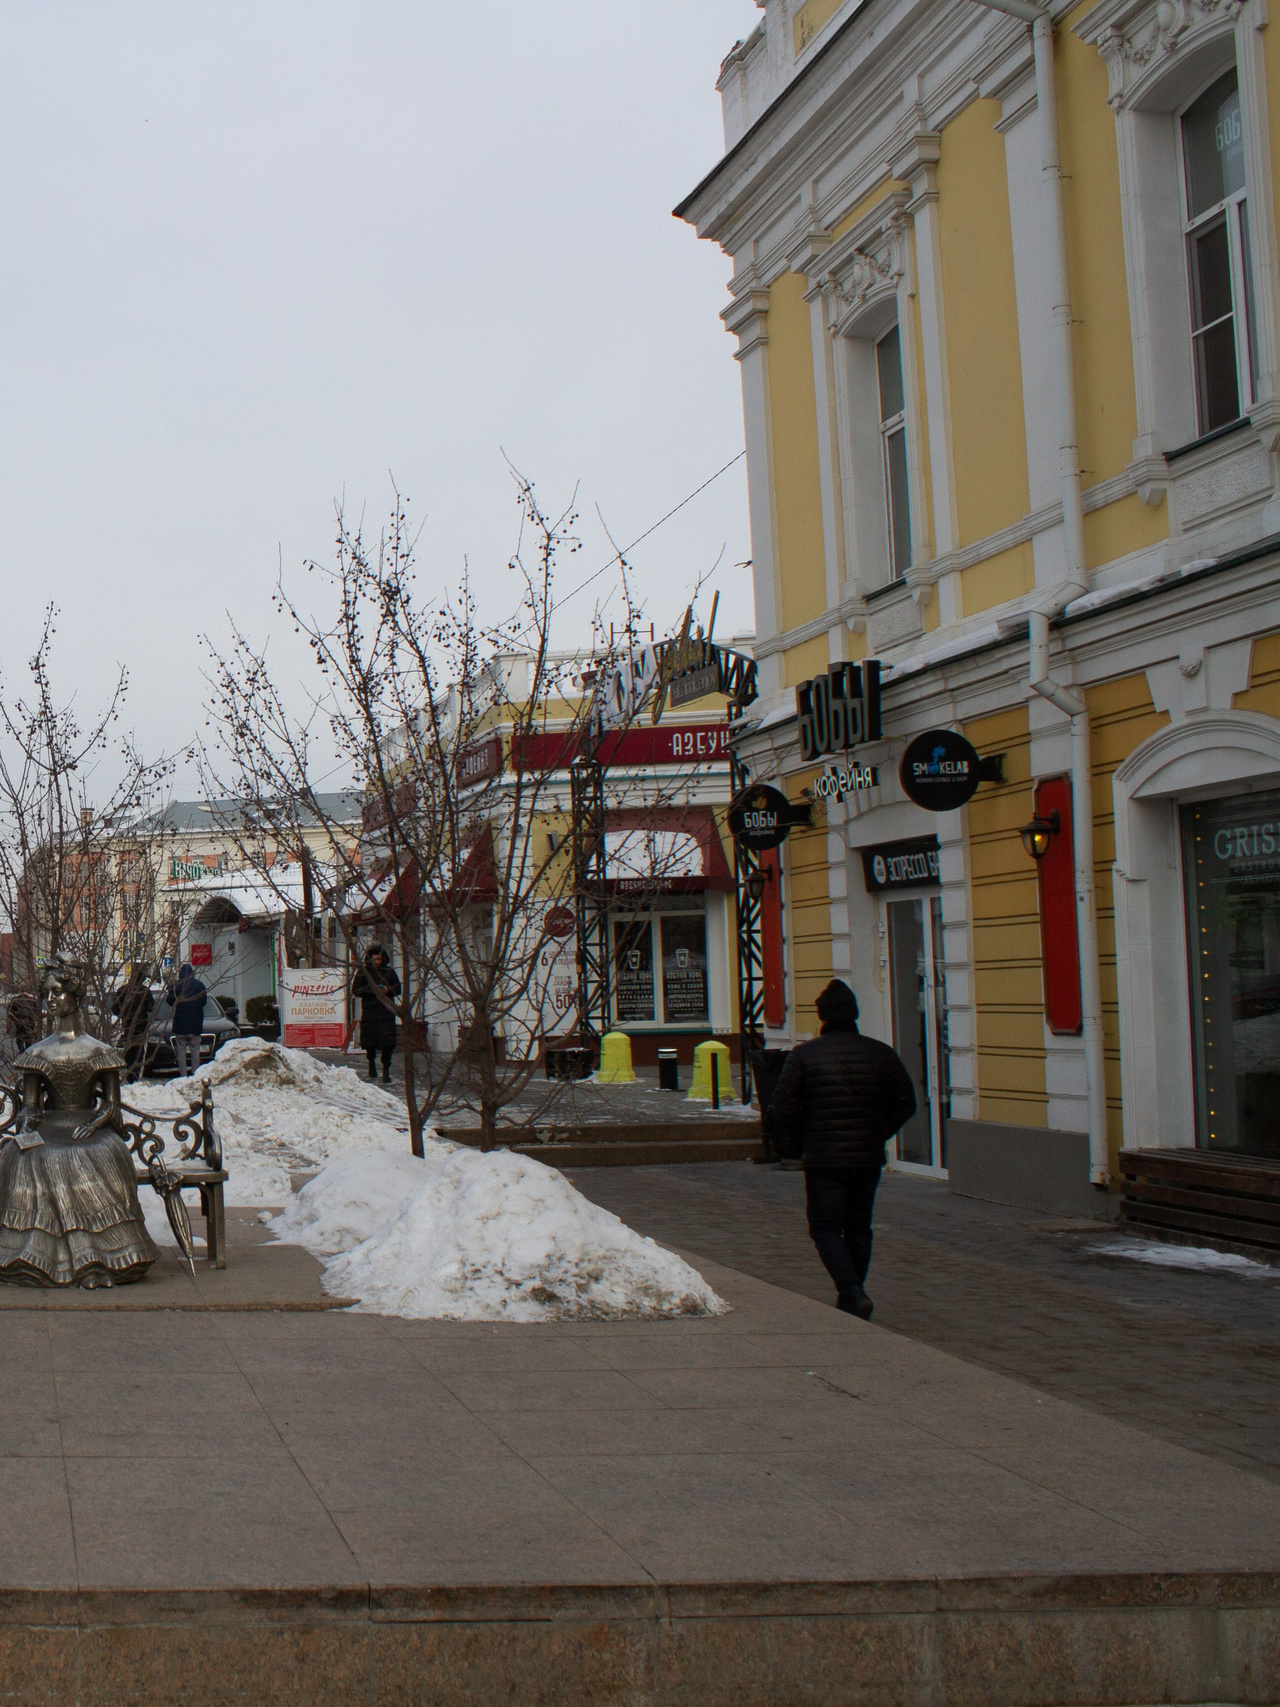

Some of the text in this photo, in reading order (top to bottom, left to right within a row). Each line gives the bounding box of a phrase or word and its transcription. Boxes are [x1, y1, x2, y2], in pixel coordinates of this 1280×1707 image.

[795, 660, 881, 761] БОБЫ
[814, 761, 877, 803] кофейня
[743, 811, 777, 828] БОБЫ
[291, 1008, 336, 1016] ПАРКОВКА
